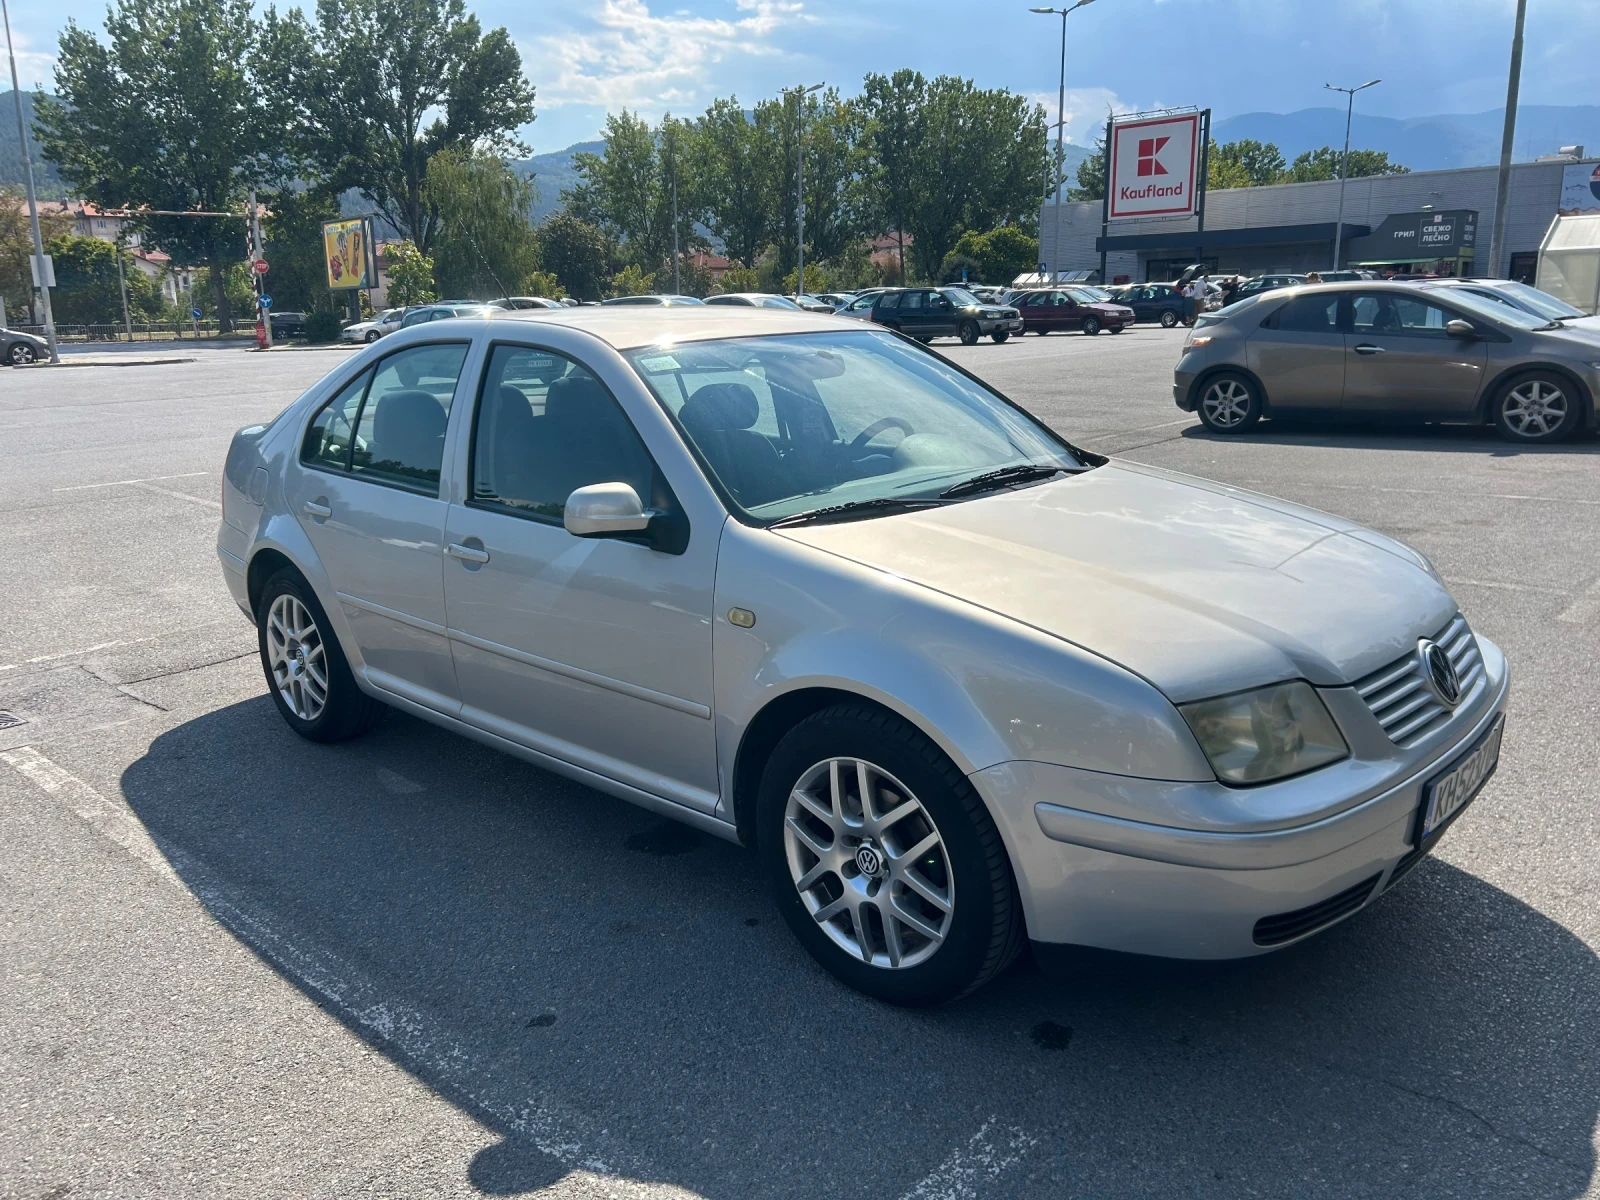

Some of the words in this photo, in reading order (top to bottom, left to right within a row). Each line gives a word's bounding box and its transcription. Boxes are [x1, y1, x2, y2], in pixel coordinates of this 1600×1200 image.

[1137, 136, 1171, 176] K
[1121, 181, 1183, 200] Kaufland
[1422, 234, 1450, 242] ЛЕСНО
[1433, 731, 1499, 823] KH5237
